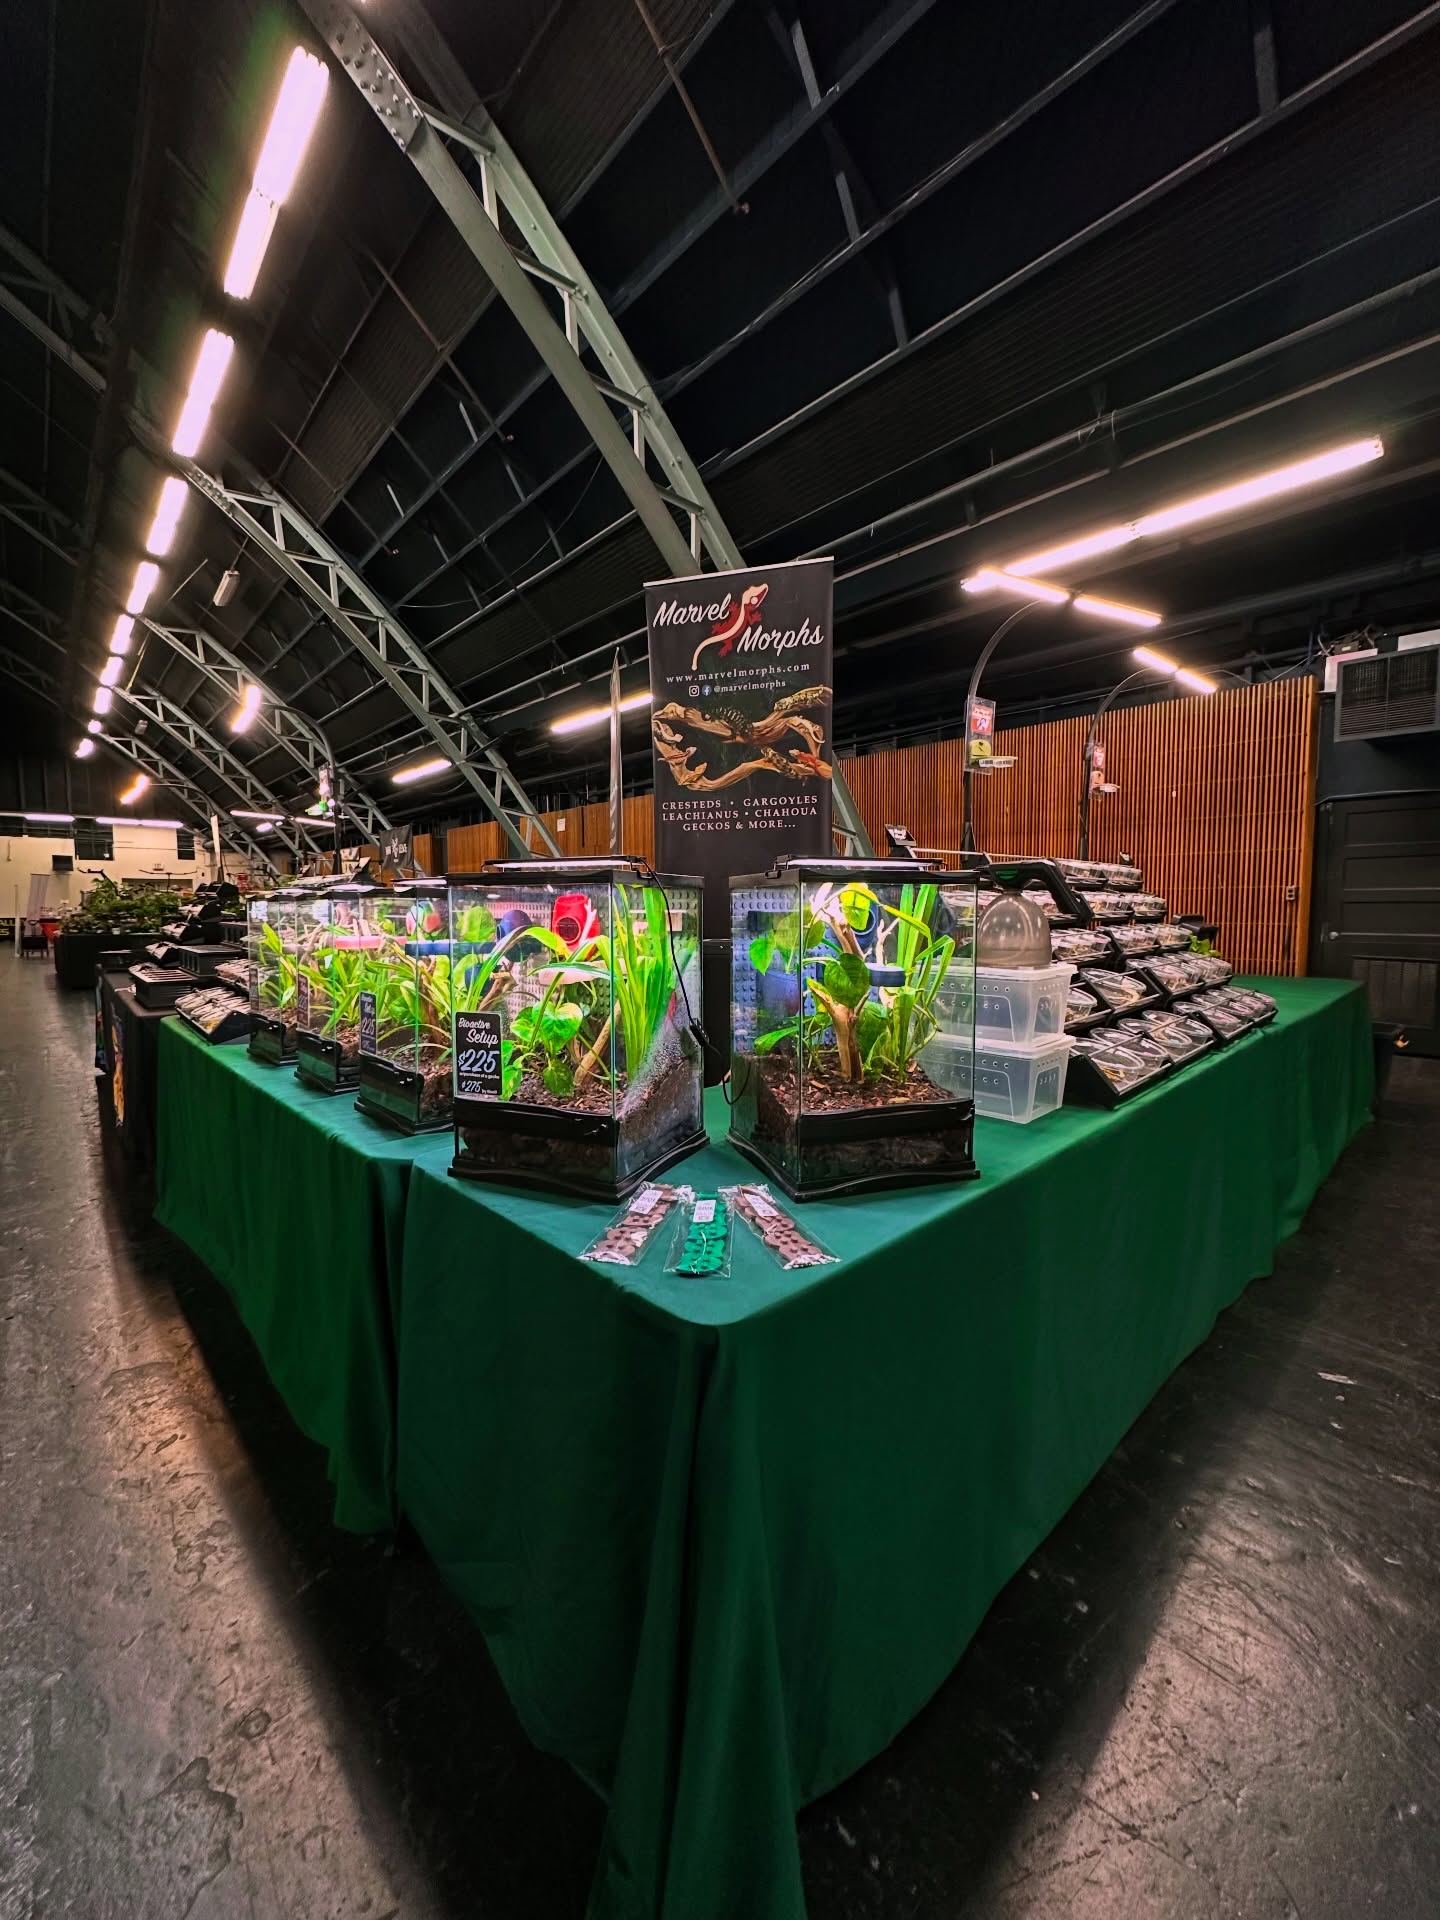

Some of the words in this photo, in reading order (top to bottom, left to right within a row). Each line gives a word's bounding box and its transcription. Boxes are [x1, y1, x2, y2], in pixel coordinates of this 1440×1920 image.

[652, 592, 732, 628] Marvel
[736, 617, 825, 657] Morphs
[666, 663, 811, 684] www.marvelmorphs.com
[713, 680, 786, 694] @marvelmorphs
[662, 800, 722, 810] CRESTEDS
[743, 795, 818, 807] GARGOYLES
[662, 811, 739, 822] LEACHIANUS
[754, 807, 818, 818] CHAHOUA
[683, 821, 731, 832] GECKOS
[735, 821, 744, 830] &
[748, 819, 796, 830] MORE...
[458, 1017, 491, 1029] Bioactive
[466, 1029, 499, 1048] Setup
[458, 1049, 500, 1073] $225
[461, 1080, 482, 1093] $275
